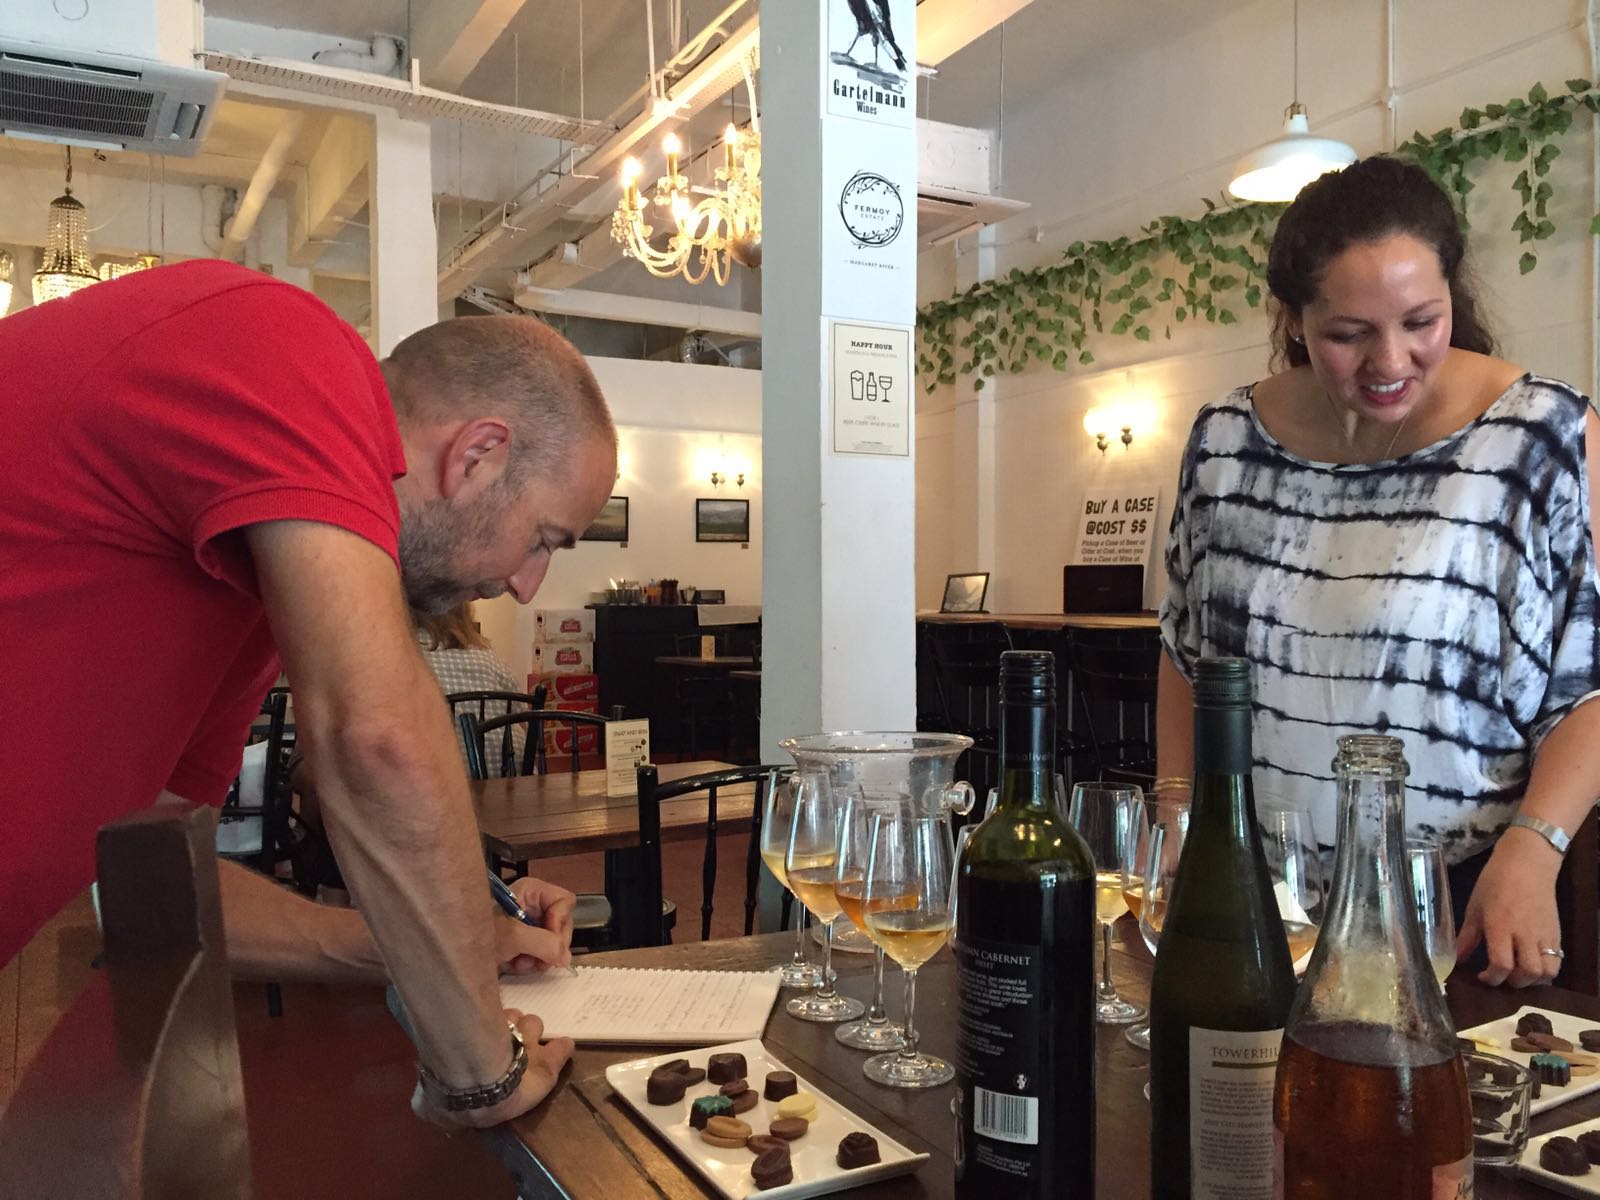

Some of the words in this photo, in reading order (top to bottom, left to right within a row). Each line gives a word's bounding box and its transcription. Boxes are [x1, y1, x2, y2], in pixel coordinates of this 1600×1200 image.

[833, 79, 905, 108] Gartelmann
[856, 101, 877, 115] Wines
[855, 205, 890, 215] FERMOY
[861, 213, 884, 221] ESTATE
[851, 341, 873, 349] HAPPY
[1085, 500, 1107, 515] BUY
[1111, 499, 1119, 513] A
[1124, 497, 1155, 512] CASE
[1086, 520, 1126, 535] @COST
[1130, 518, 1147, 533] $$
[1133, 548, 1144, 556] you
[981, 950, 1031, 965] CABERNET
[1212, 1046, 1280, 1059] TOWERHIL
